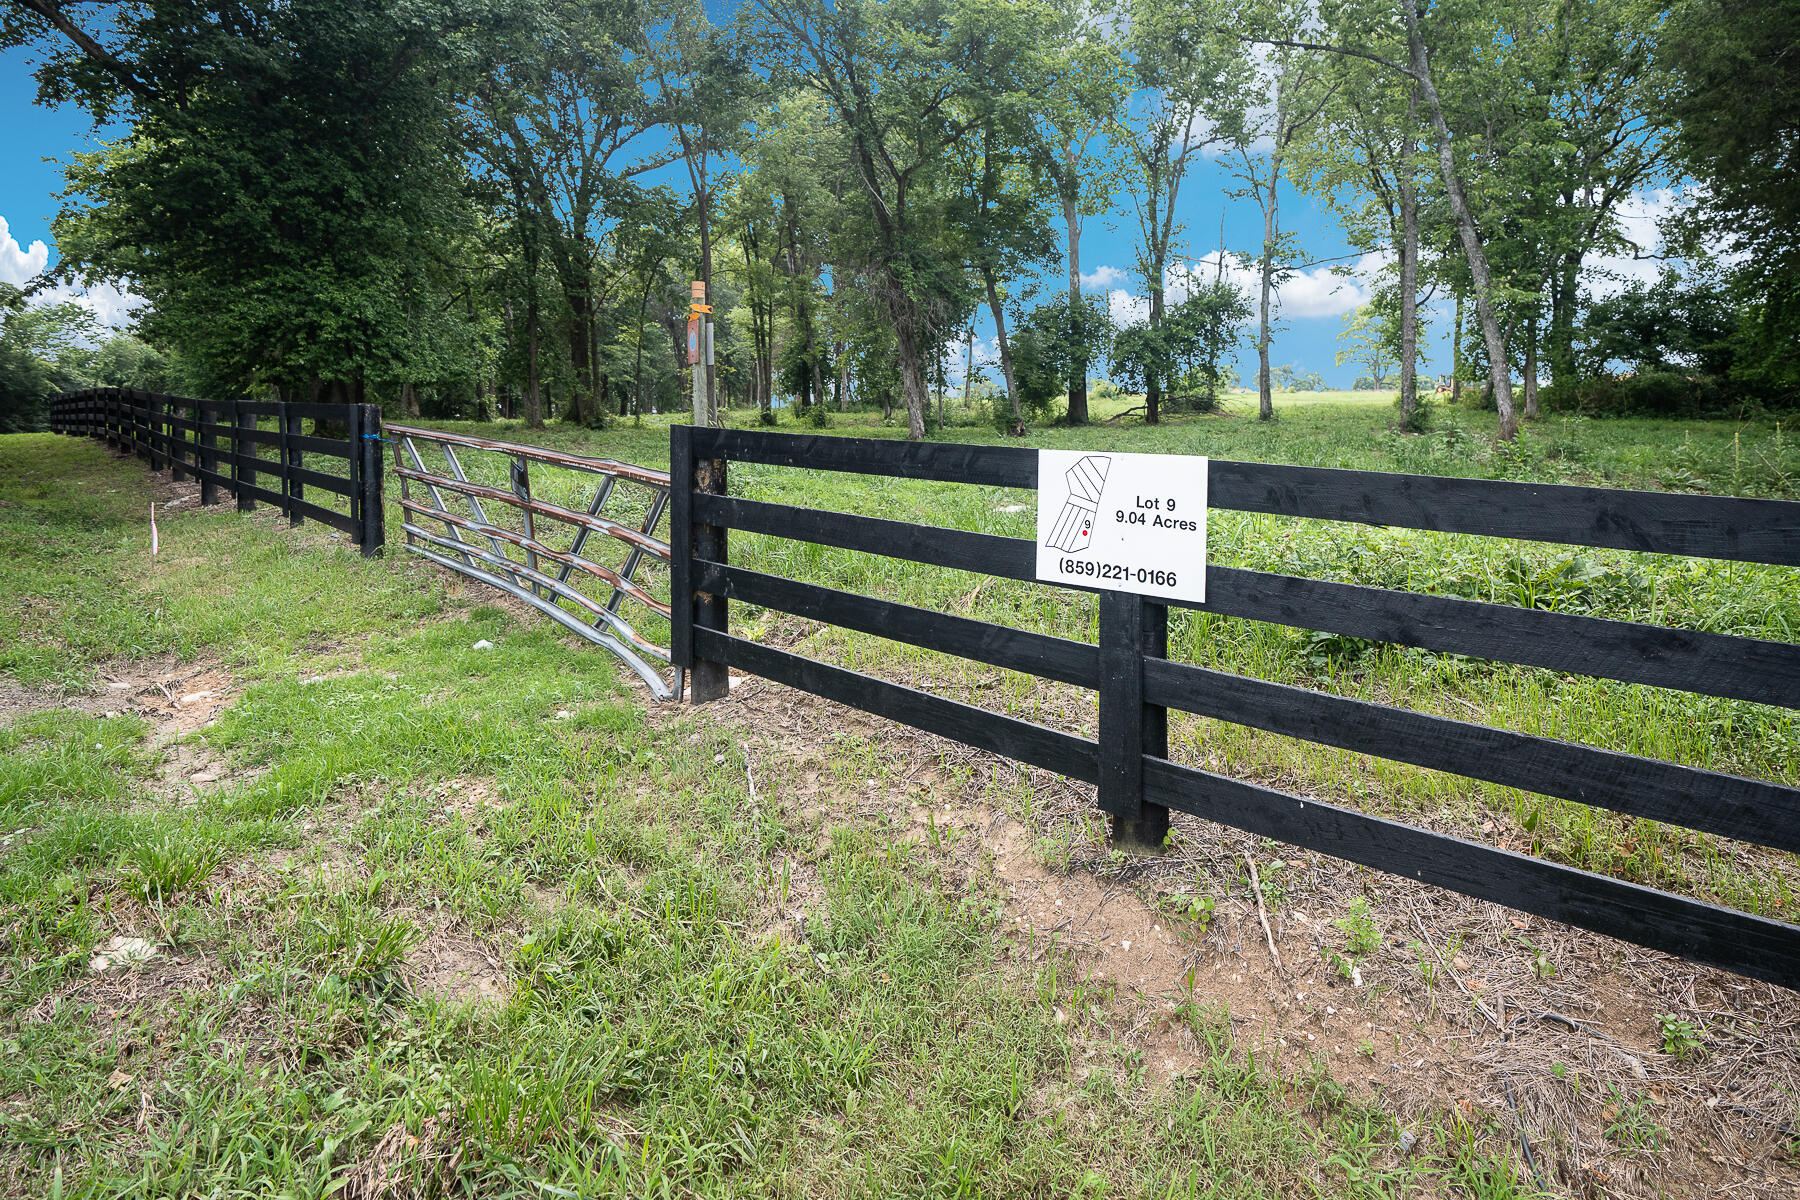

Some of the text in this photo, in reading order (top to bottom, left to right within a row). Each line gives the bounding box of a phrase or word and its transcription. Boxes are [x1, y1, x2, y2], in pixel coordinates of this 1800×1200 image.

[1136, 496, 1176, 511] Lot 9
[1084, 520, 1091, 529] 9
[1115, 510, 1197, 531] 9.04 Acres
[1059, 557, 1177, 587] (859)221-0166
